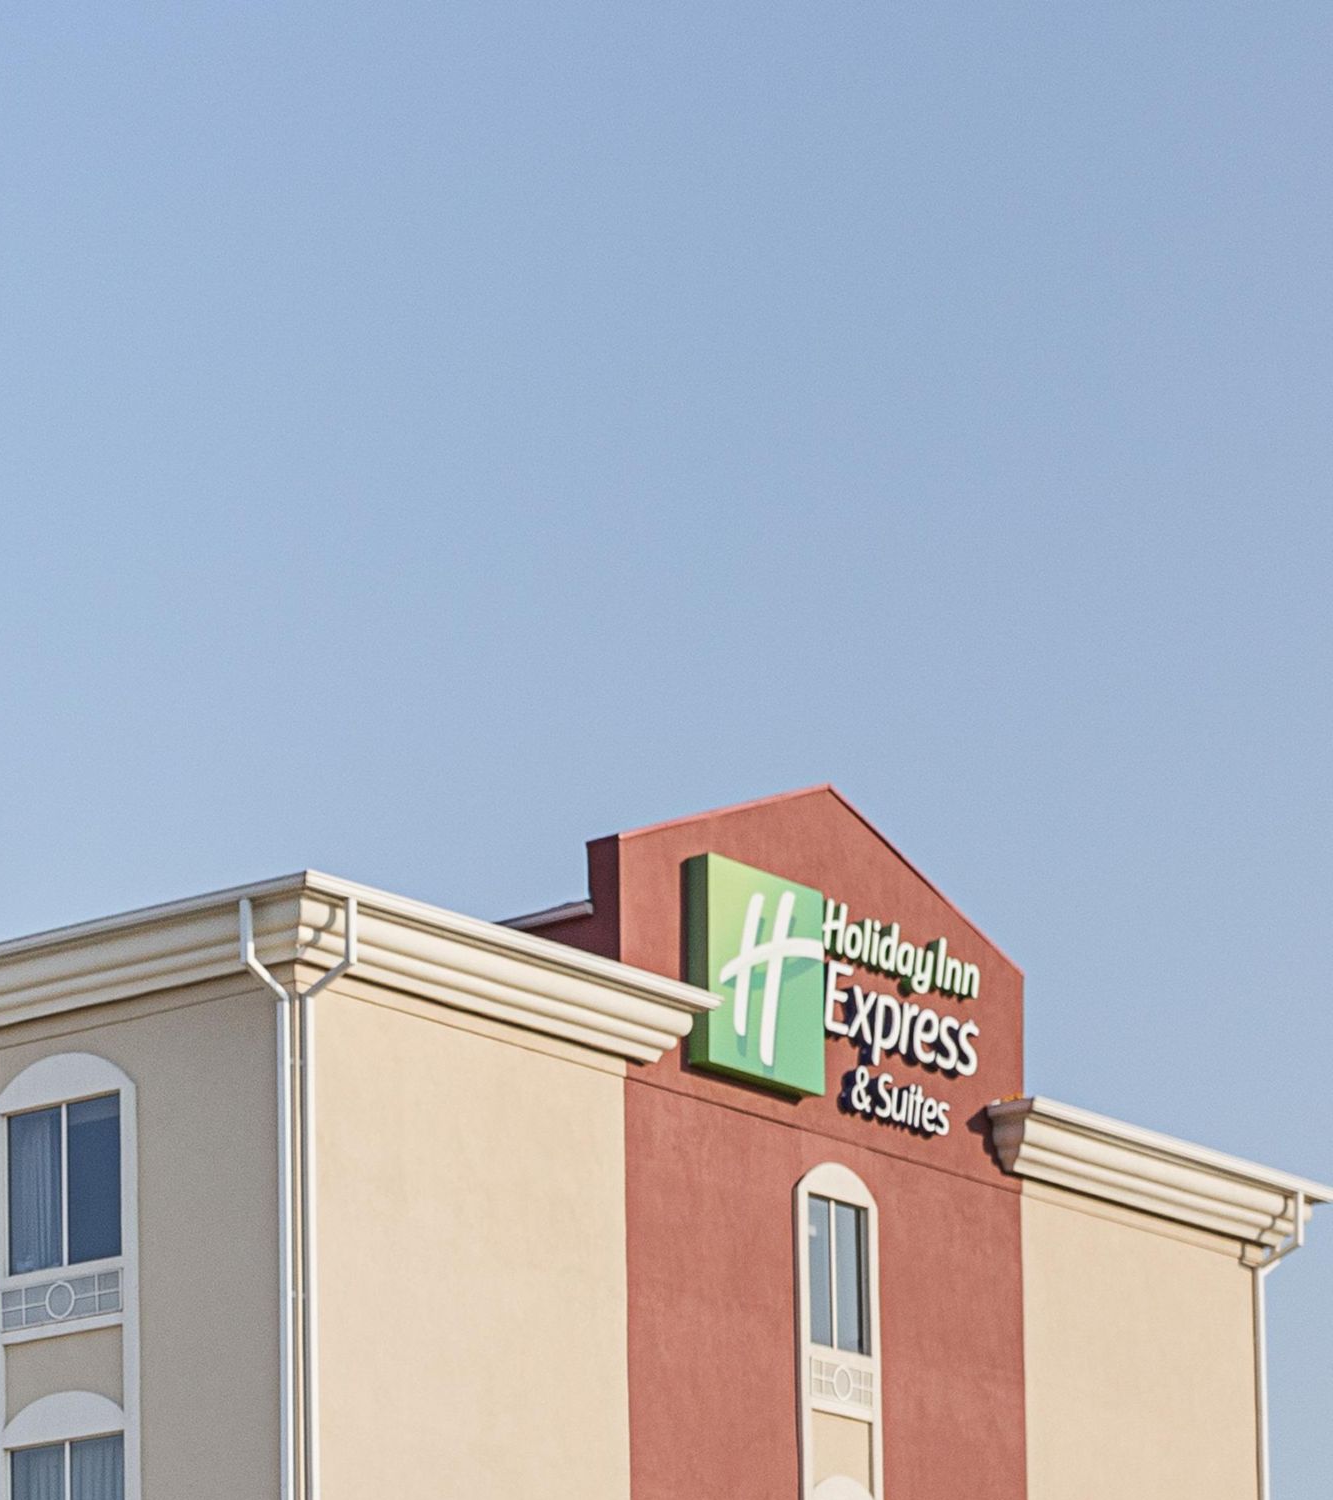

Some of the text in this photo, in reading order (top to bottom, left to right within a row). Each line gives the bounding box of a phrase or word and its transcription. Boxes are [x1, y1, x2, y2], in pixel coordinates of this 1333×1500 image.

[823, 898, 980, 999] Holiday Inn
[824, 960, 979, 1077] Express
[851, 1066, 950, 1136] & Suites
